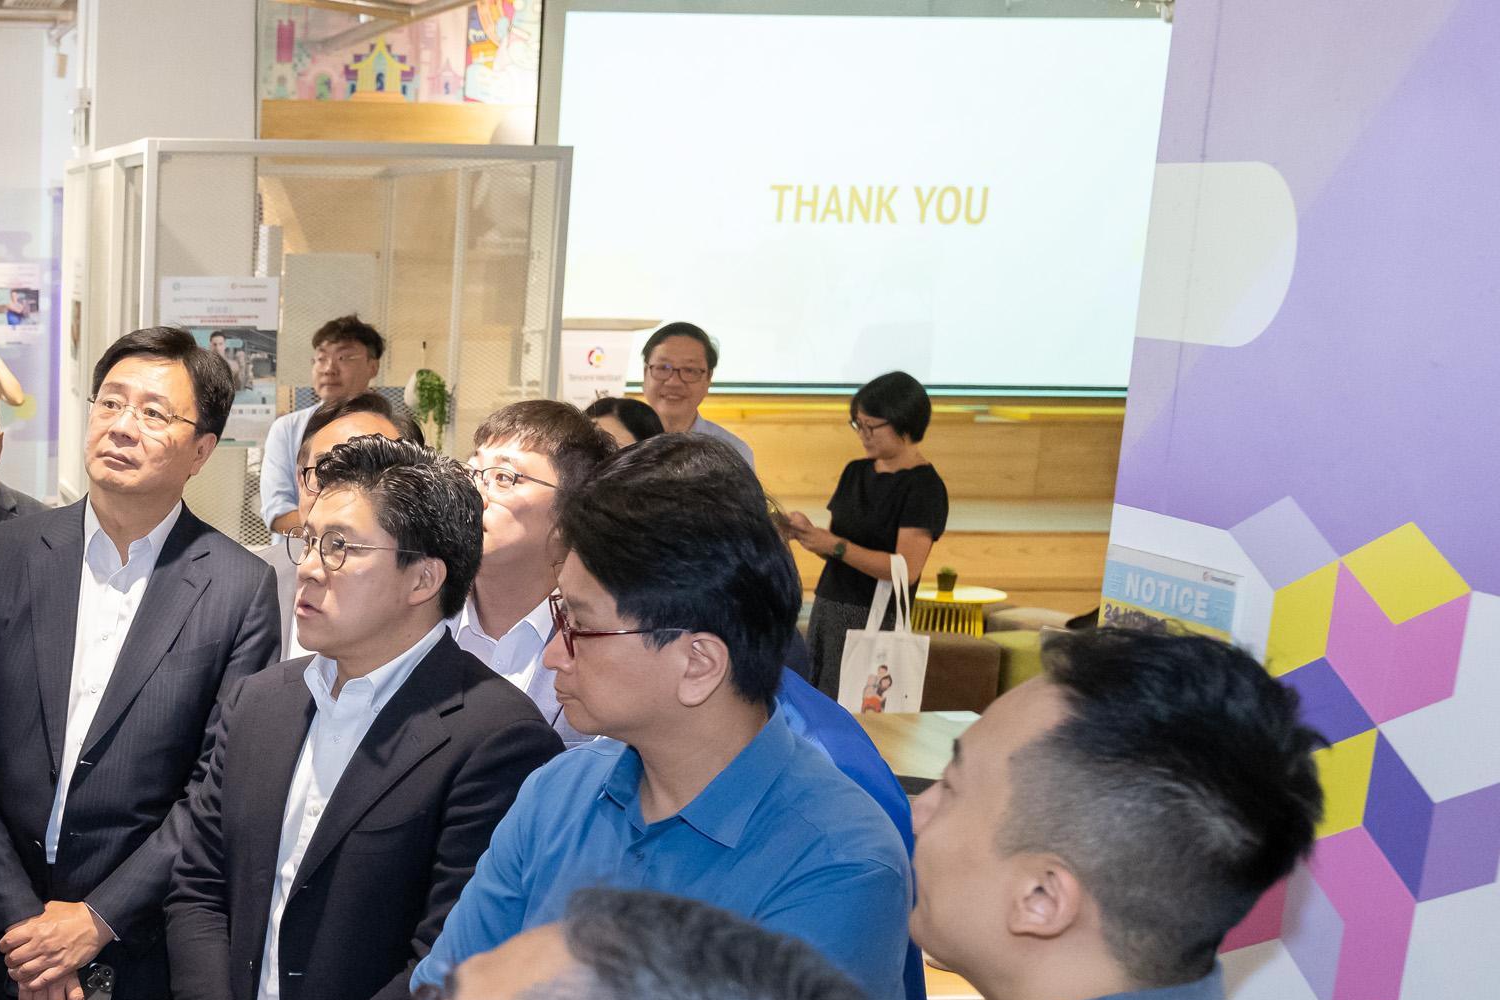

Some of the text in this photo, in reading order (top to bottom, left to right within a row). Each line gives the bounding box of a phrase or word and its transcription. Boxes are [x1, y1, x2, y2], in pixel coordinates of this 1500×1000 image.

[770, 184, 990, 226] THANK YOU
[1124, 571, 1210, 618] NOTICE
